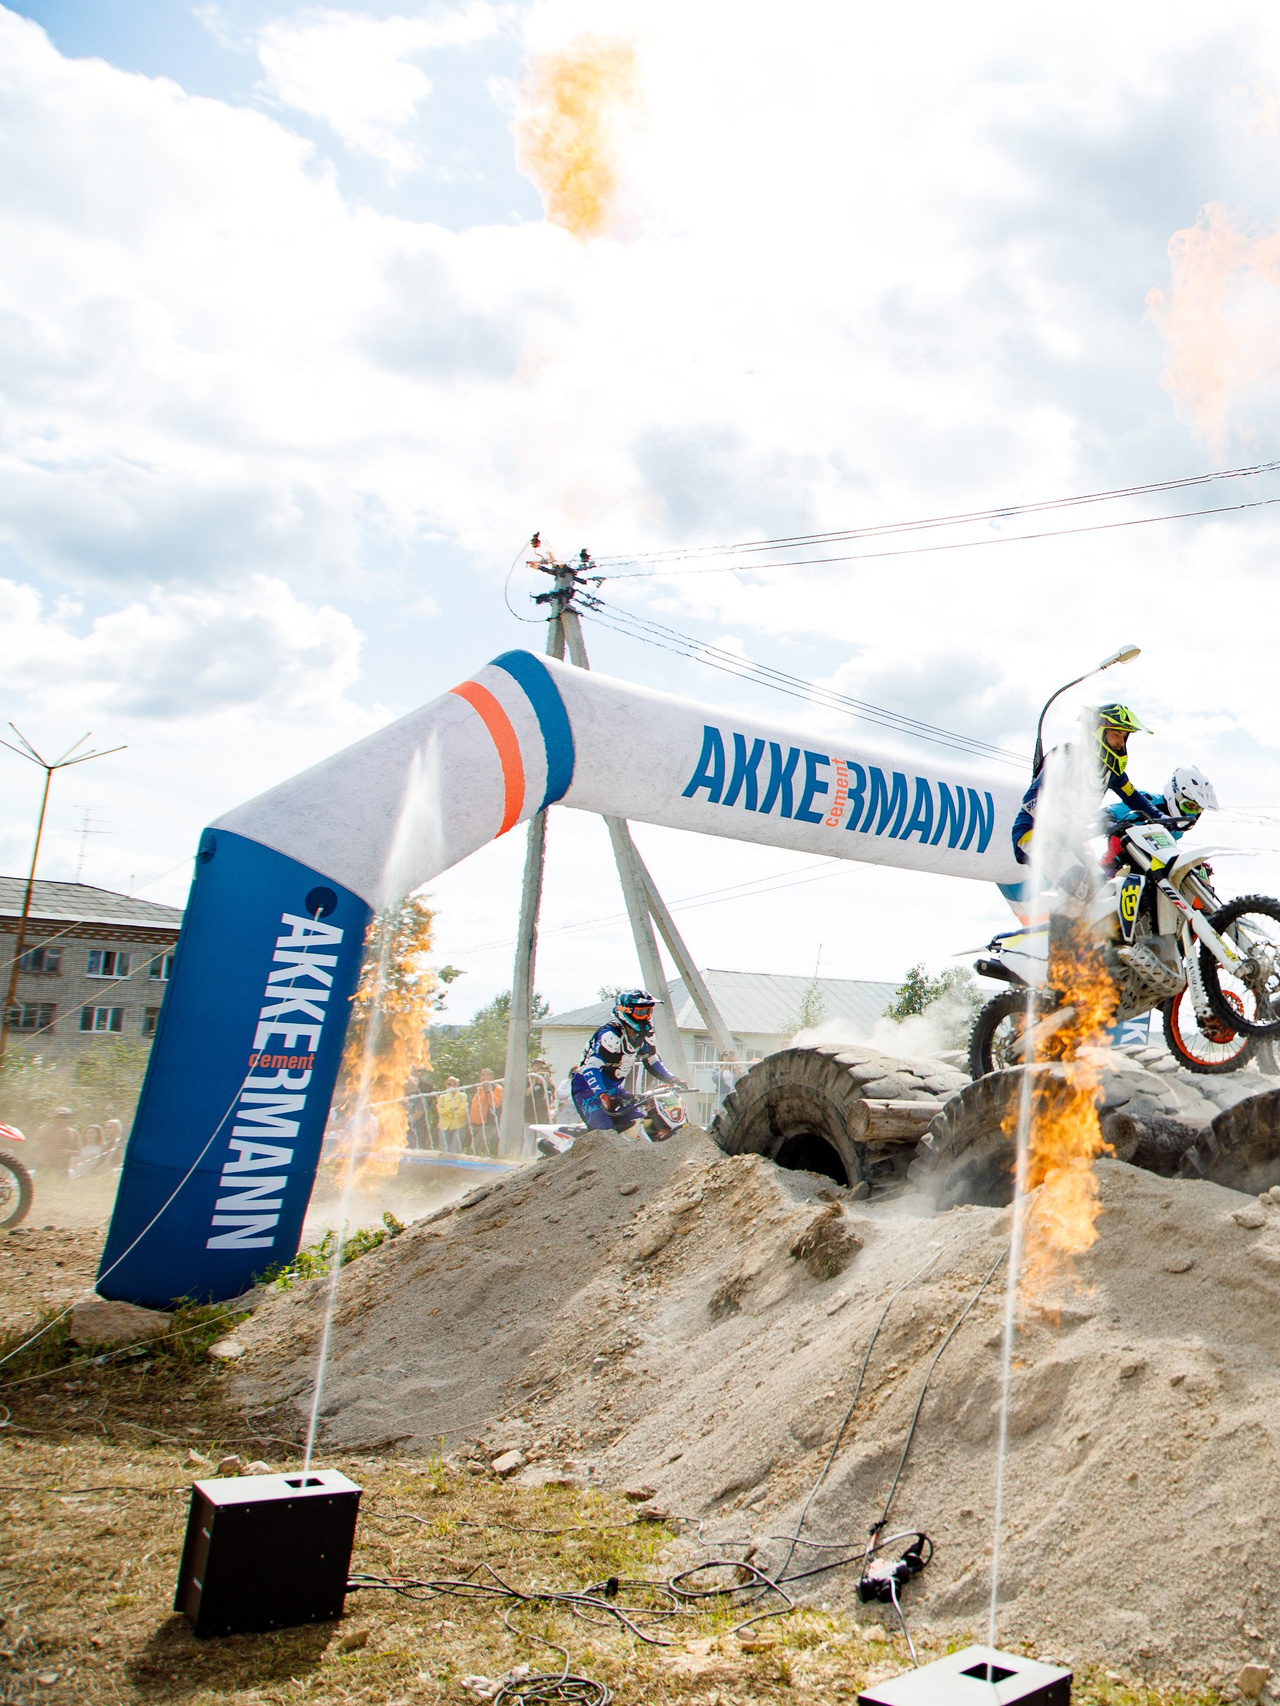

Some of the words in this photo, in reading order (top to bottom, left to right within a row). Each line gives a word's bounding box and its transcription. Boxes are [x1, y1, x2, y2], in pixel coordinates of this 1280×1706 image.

[681, 725, 995, 853] AKKERMANN
[825, 757, 849, 827] cement
[206, 913, 345, 1250] AKKERMANN
[248, 1052, 315, 1070] cement
[583, 1070, 602, 1093] FOX
